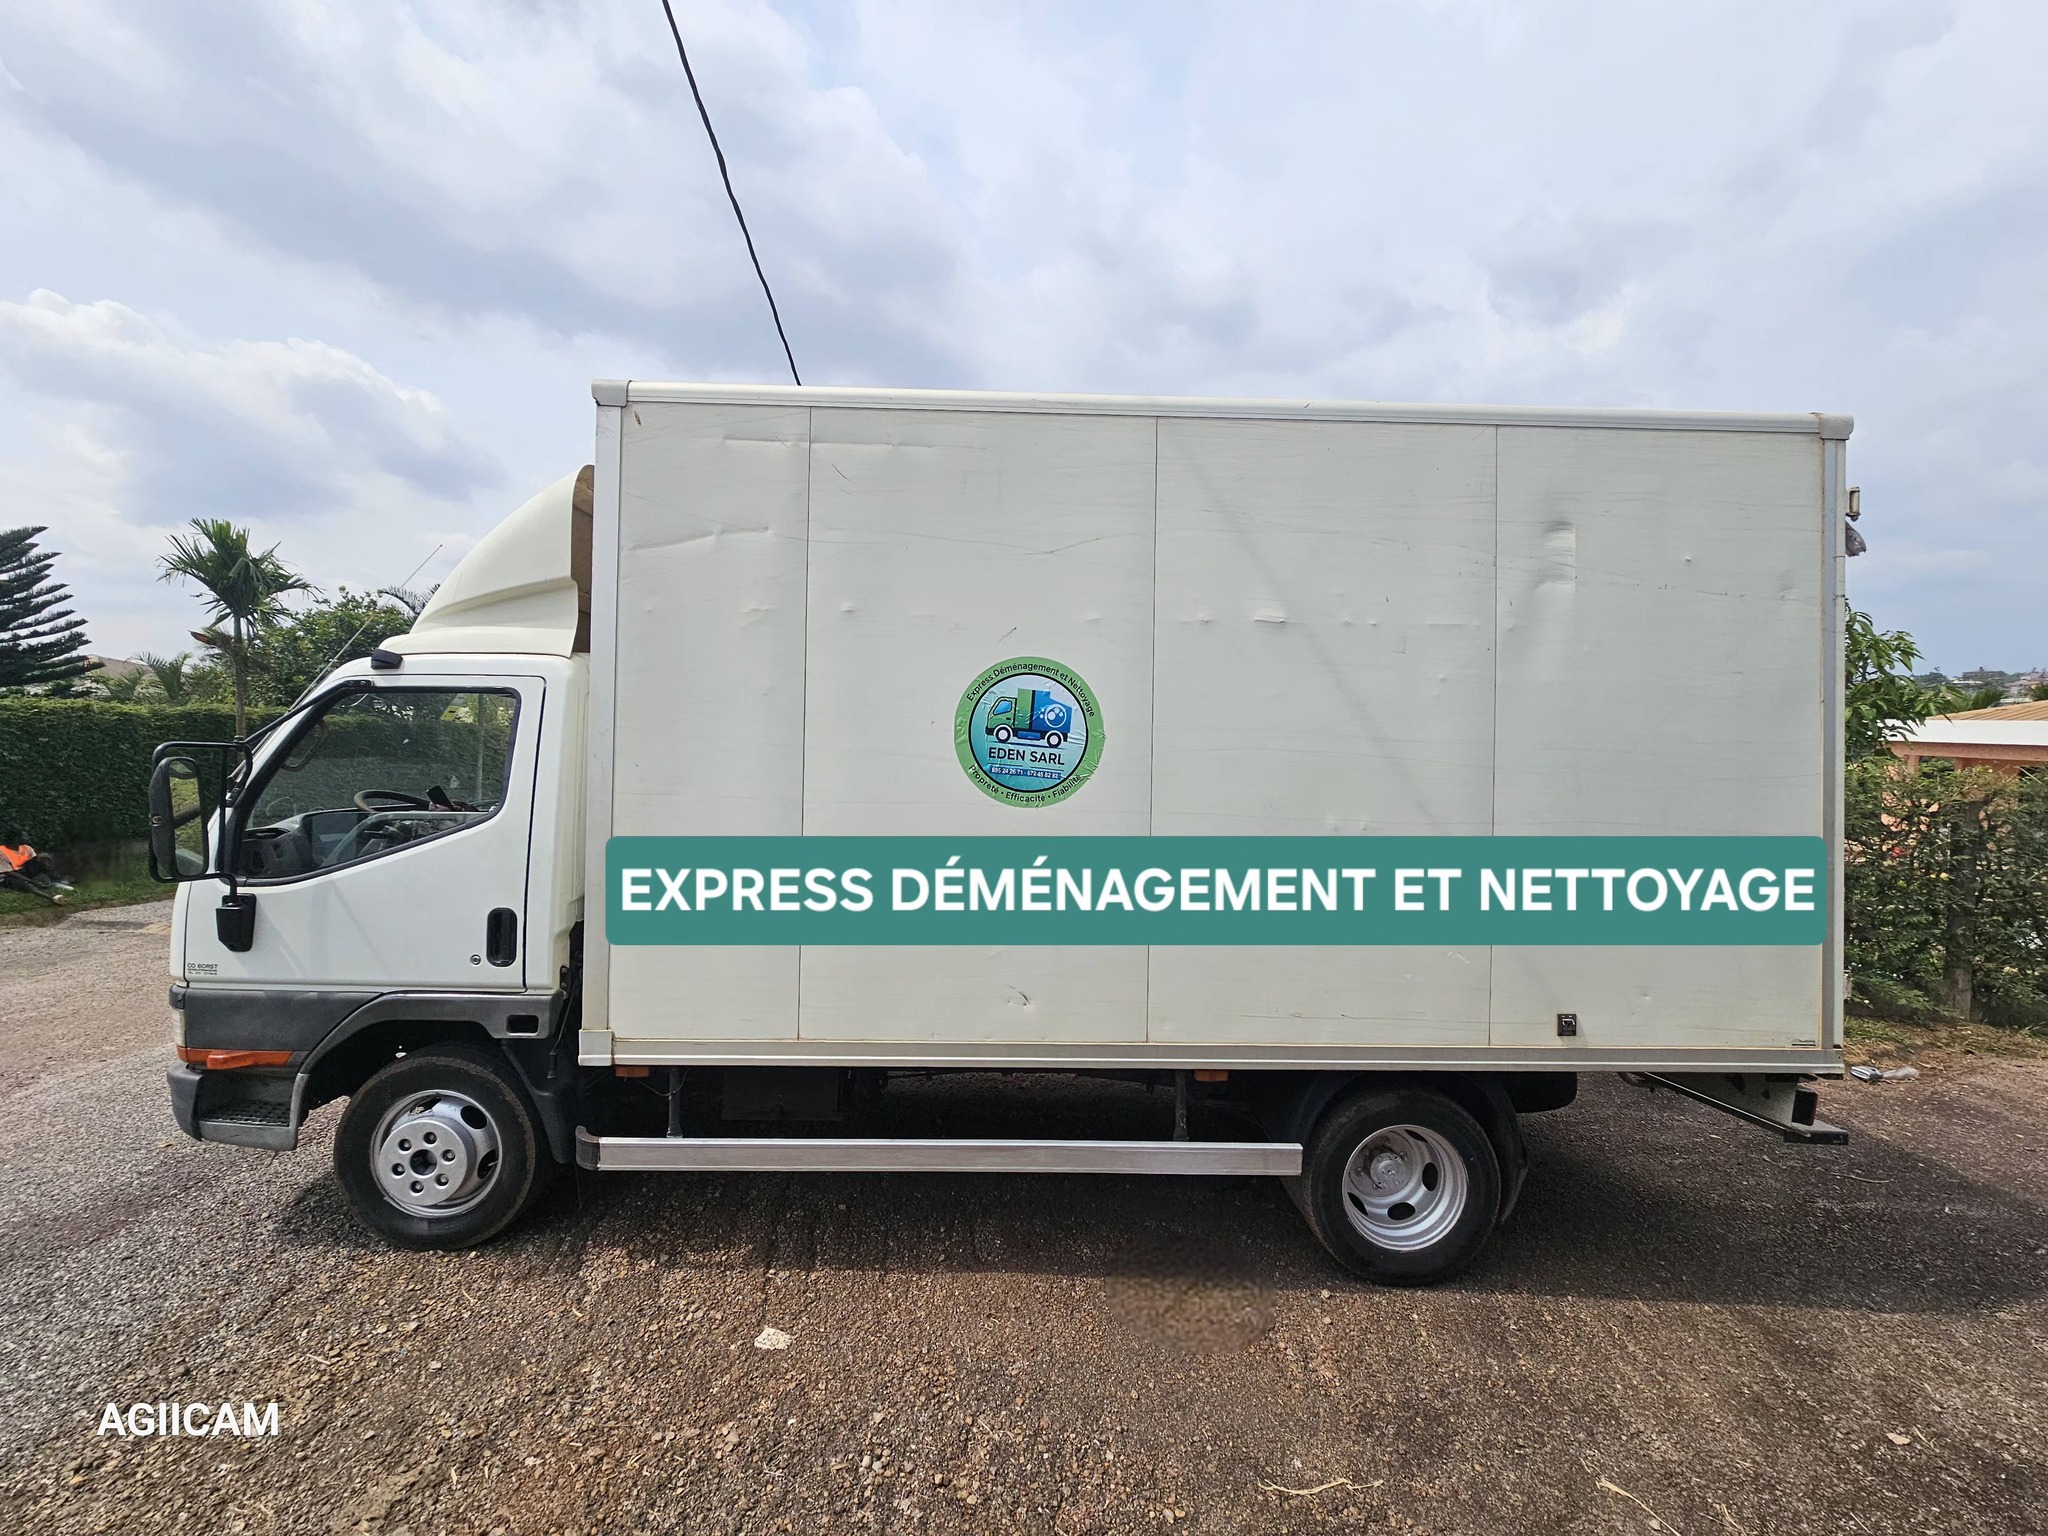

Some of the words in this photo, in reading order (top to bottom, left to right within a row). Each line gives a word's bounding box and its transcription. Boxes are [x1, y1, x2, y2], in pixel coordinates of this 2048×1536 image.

[966, 674, 994, 701] Express
[993, 663, 1060, 677] Déménagement
[1059, 672, 1068, 682] et
[1067, 677, 1095, 717] Nettoyage
[988, 747, 1025, 761] EDEN
[1029, 751, 1065, 766] SARL
[968, 764, 999, 795] Propreté
[1005, 791, 1046, 803] Efficacité
[1052, 774, 1083, 799] Fiabilité
